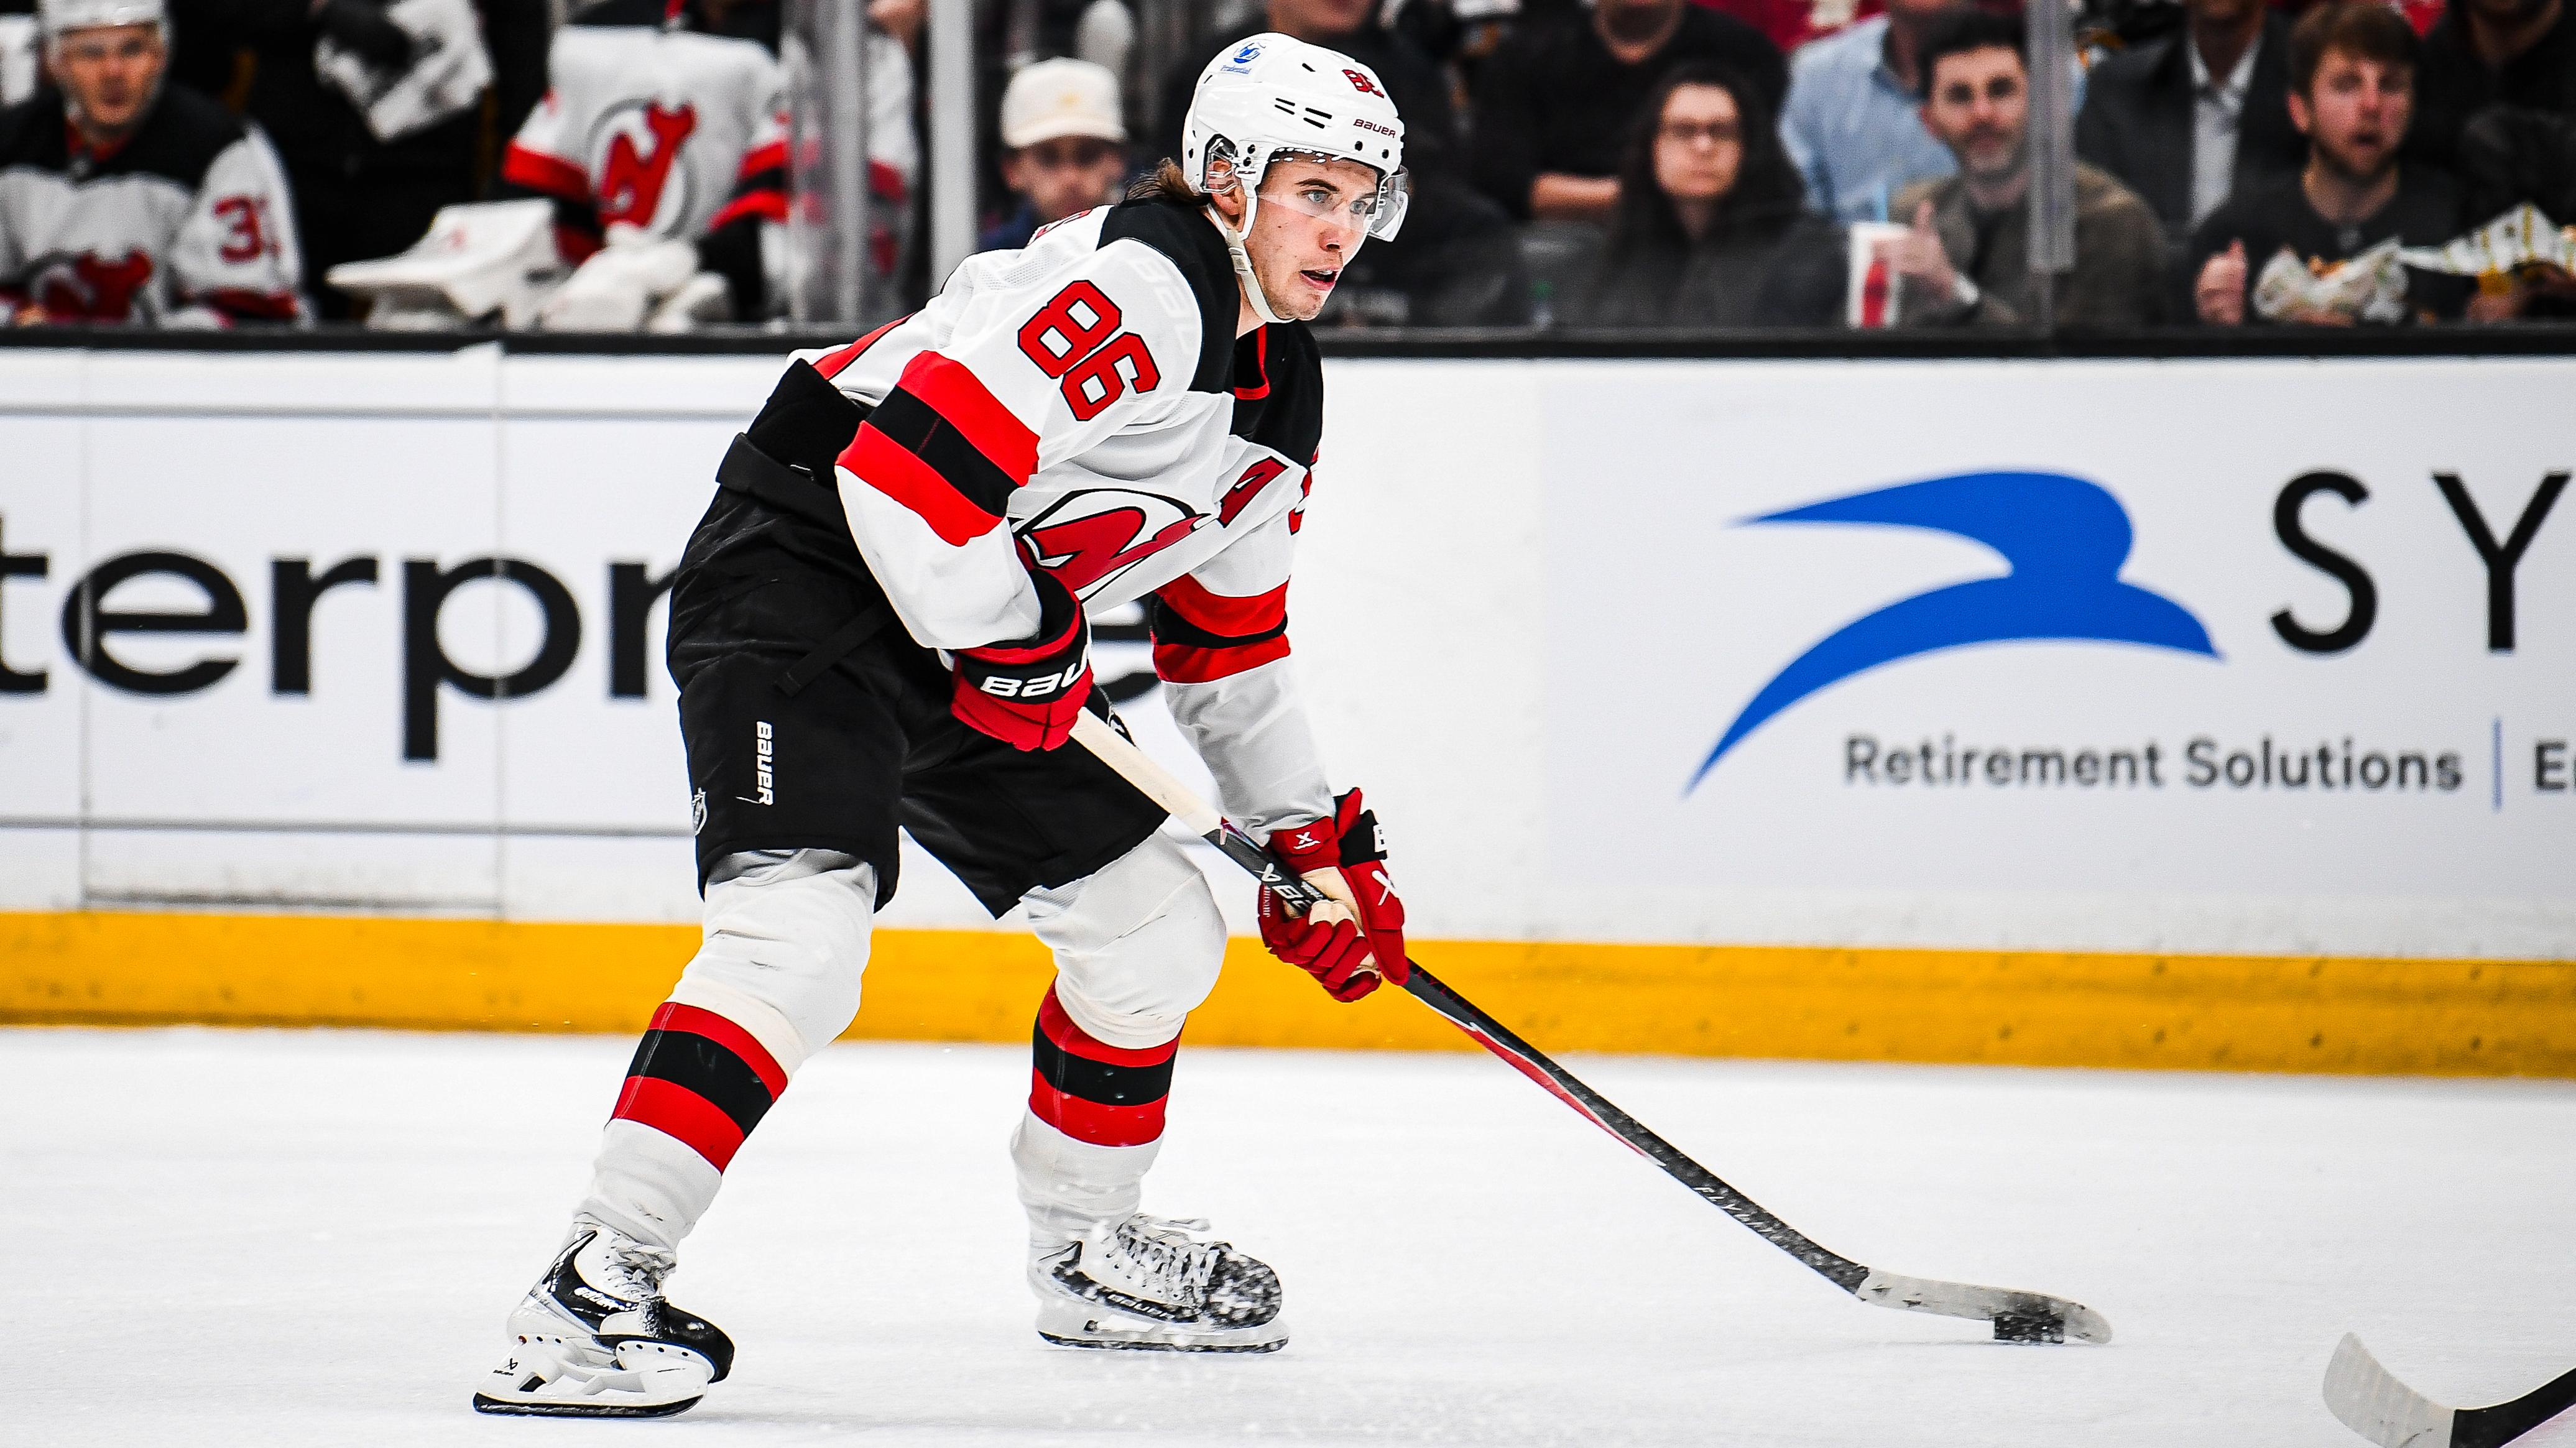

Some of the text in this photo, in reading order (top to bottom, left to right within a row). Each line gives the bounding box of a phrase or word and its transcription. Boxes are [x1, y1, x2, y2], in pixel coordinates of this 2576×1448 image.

[1017, 279, 1161, 422] 86
[2271, 470, 2573, 655] SY
[1844, 734, 2463, 790] Retirement Solutions
[2534, 740, 2576, 791] E
